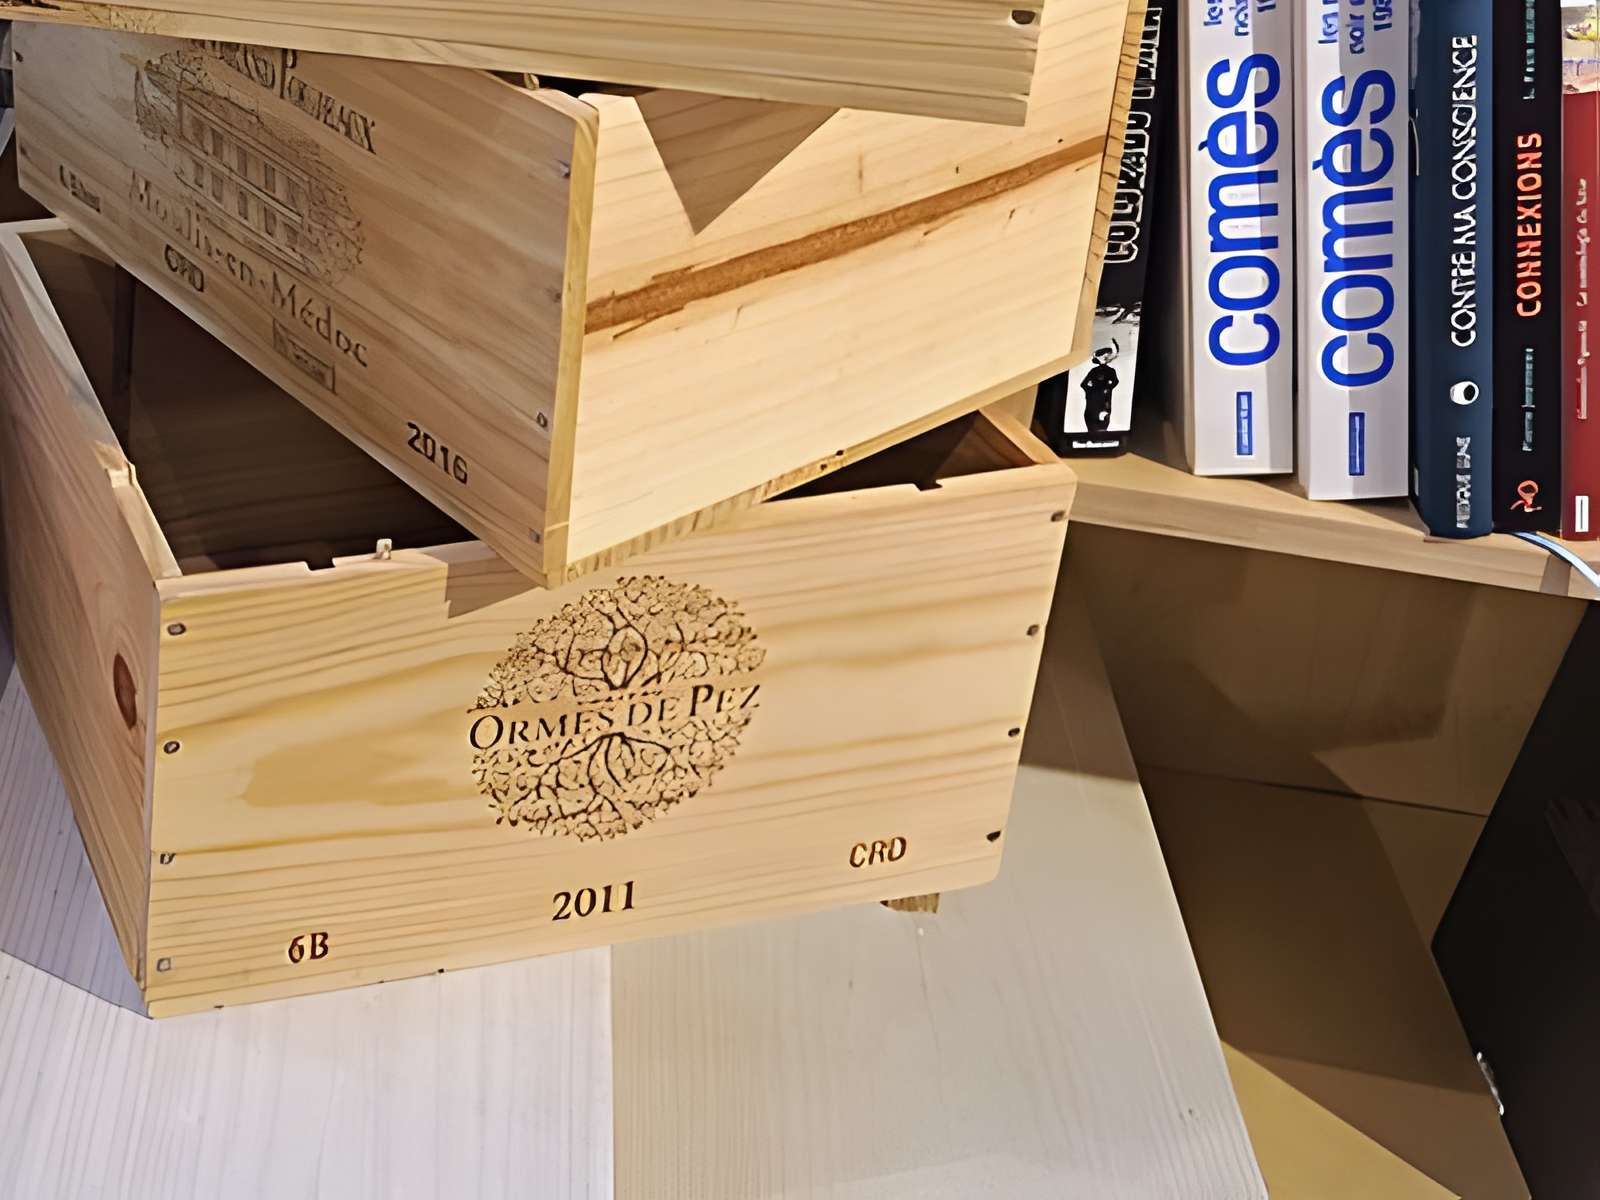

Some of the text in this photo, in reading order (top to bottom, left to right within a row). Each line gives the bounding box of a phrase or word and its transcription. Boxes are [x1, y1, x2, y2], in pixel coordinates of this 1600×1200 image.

[1450, 35, 1478, 200] CONSCIENCE
[1198, 53, 1280, 366] comès
[1312, 68, 1396, 388] comès
[1516, 132, 1542, 317] CONNEXIONS
[1451, 251, 1477, 347] CONTRE
[406, 420, 469, 486] 2016
[627, 696, 681, 728] DE
[690, 683, 761, 718] PEZ
[848, 834, 908, 870] CRD
[551, 880, 636, 923] 2011
[287, 930, 330, 965] 6B
